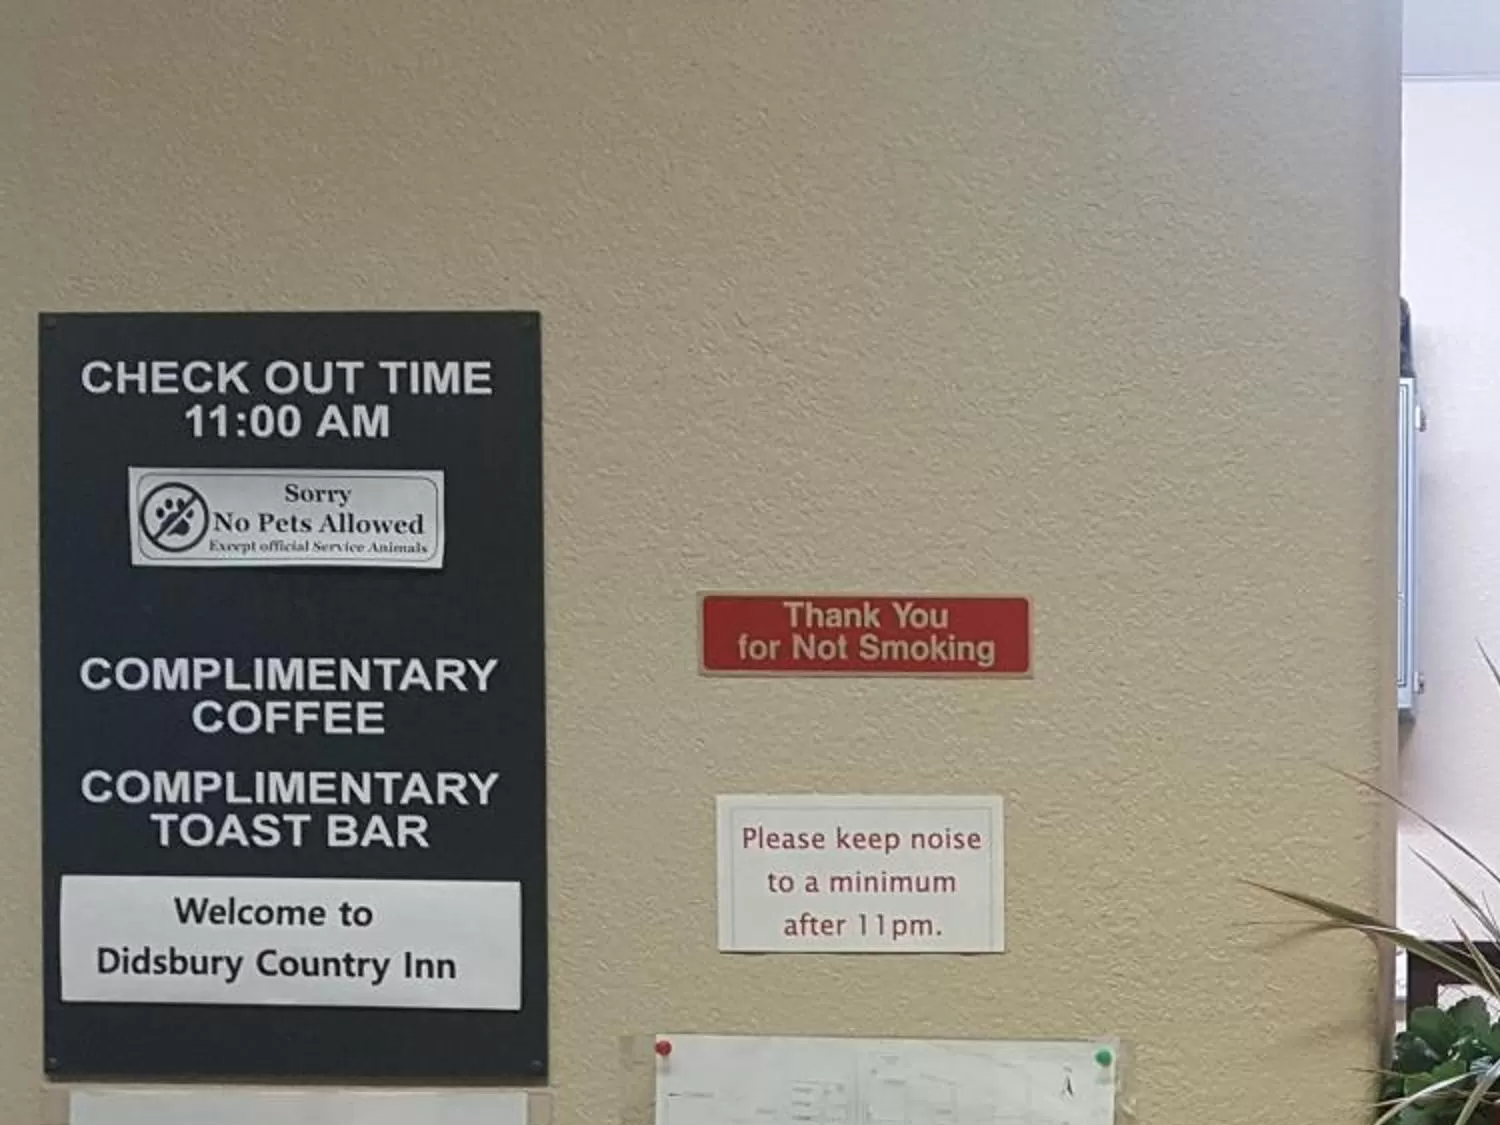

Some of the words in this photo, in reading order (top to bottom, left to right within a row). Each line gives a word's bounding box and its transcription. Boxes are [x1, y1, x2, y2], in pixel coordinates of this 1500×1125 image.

[80, 360, 250, 395] CHECK
[264, 360, 365, 395] OUT
[379, 361, 493, 395] TIME
[184, 404, 302, 438] 11:00
[315, 404, 391, 438] AM
[284, 483, 352, 507] Sorry
[213, 511, 250, 533] No
[258, 512, 313, 534] Pets
[318, 512, 425, 535] Allowed
[209, 539, 256, 555] Except
[258, 539, 310, 553] official
[313, 540, 365, 554] Service
[367, 541, 428, 554] Animals
[783, 600, 881, 629] Thank
[892, 601, 949, 629] You
[737, 633, 781, 659] for
[792, 633, 848, 660] Not
[858, 634, 997, 667] Smoking
[79, 656, 499, 692] COMPLIMENTARY
[191, 700, 385, 735] COFFEE
[80, 769, 500, 806] COMPLIMENTARY
[150, 813, 311, 848] TOAST
[327, 814, 430, 848] BAR
[742, 826, 826, 850] Please
[836, 826, 901, 855] keep
[910, 826, 983, 850] noise
[767, 872, 794, 894] to
[804, 876, 820, 894] a
[829, 870, 957, 894] minimum
[173, 896, 326, 927] Welcome
[338, 901, 374, 927] to
[783, 913, 847, 937] after
[857, 913, 943, 941] 11pm.
[96, 946, 244, 983] Didsbury
[256, 948, 392, 985] Country
[404, 951, 458, 980] Inn
